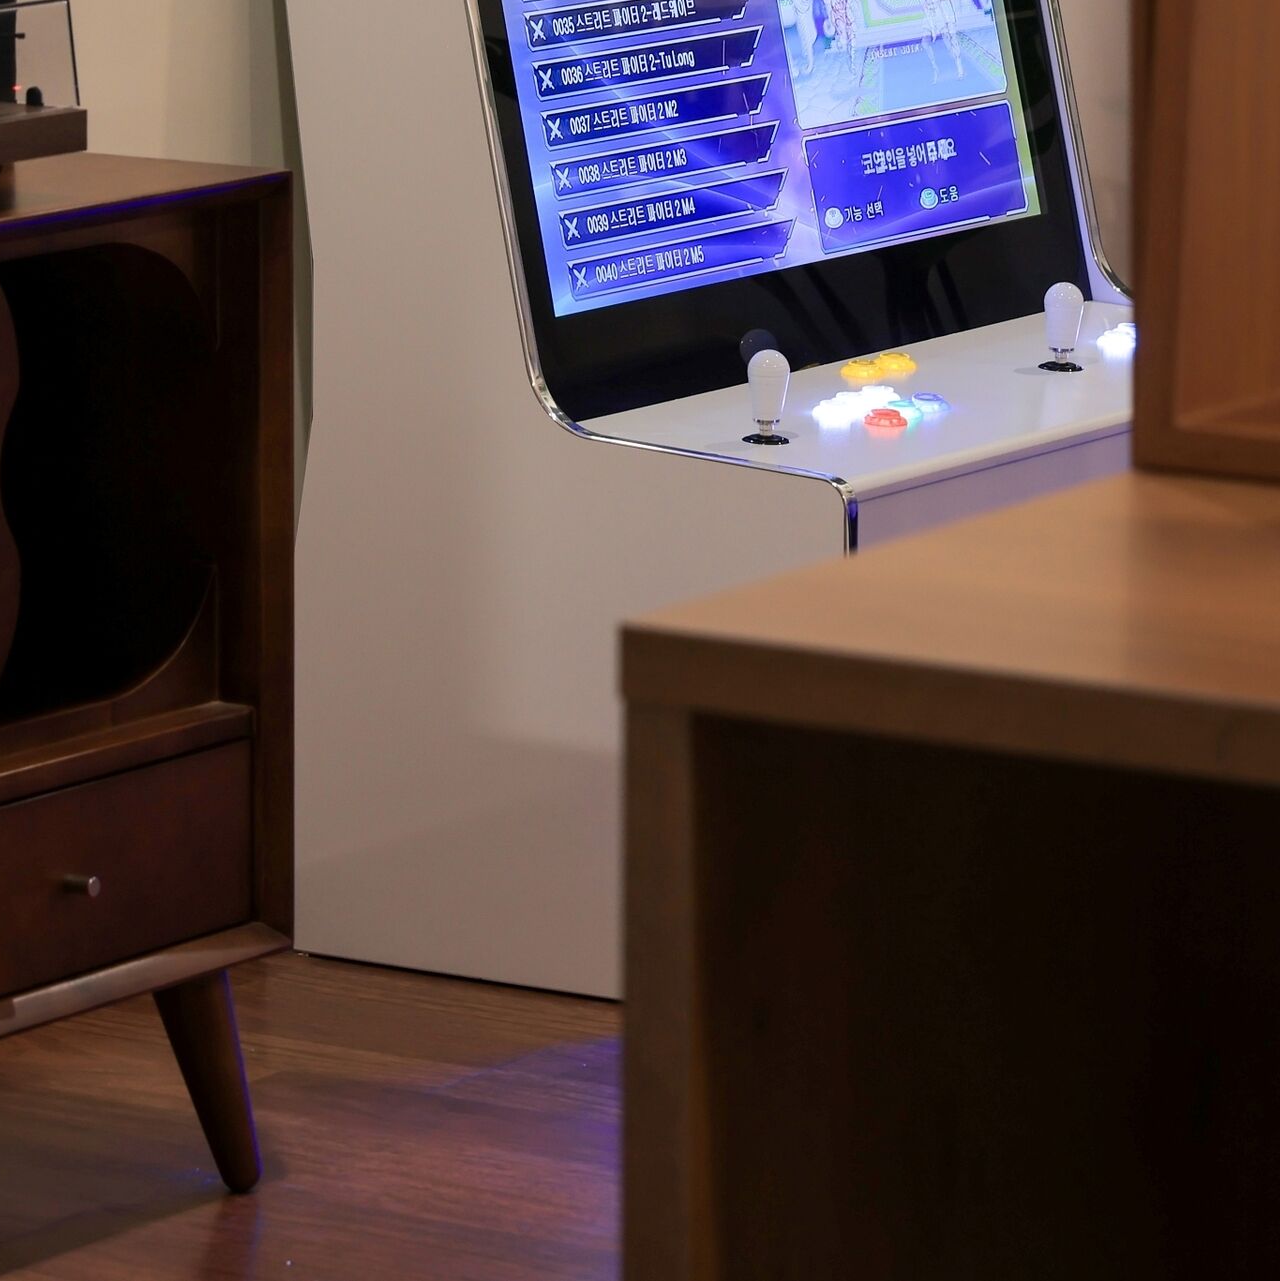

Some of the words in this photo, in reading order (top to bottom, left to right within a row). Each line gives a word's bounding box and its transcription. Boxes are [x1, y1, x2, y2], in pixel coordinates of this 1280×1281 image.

[552, 16, 575, 36] 0035
[576, 9, 612, 32] 스트리트
[611, 5, 640, 27] 파이터
[561, 65, 584, 86] 0036
[585, 58, 621, 82] 스트리트
[620, 53, 649, 76] 파이터
[671, 50, 695, 68] Long
[569, 114, 591, 136] 0037
[593, 107, 629, 131] 스트리트
[629, 102, 657, 125] 파이터
[664, 99, 679, 119] M2
[578, 164, 601, 185] 0038
[602, 156, 638, 180] 스트리트
[638, 151, 666, 173] 파이터
[673, 148, 687, 167] M3
[844, 206, 863, 222] 기능
[866, 200, 884, 219] 선택
[939, 185, 960, 204] 도움
[587, 213, 609, 234] 0039
[610, 206, 647, 229] 스트리트
[646, 200, 674, 222] 파이터
[681, 196, 696, 216] M4
[595, 263, 618, 283] 0040
[619, 255, 655, 279] 스트리트
[654, 249, 683, 271] 파이터
[690, 245, 705, 265] M5
